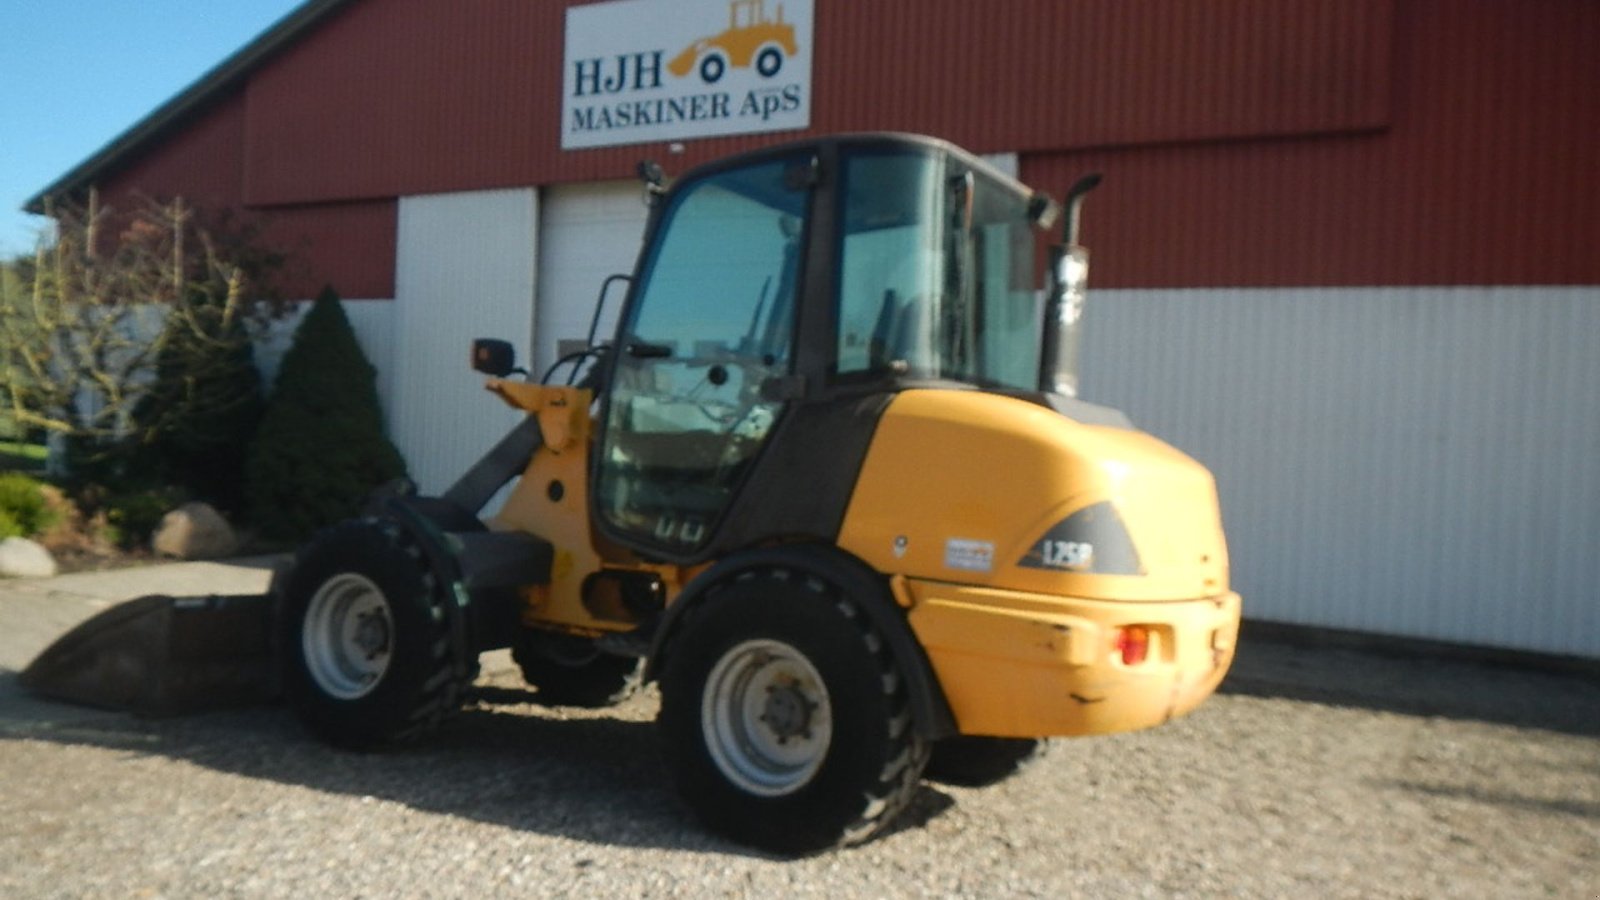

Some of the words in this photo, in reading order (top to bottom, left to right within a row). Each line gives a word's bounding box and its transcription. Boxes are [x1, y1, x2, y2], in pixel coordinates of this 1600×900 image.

[573, 50, 664, 96] HJH
[572, 93, 730, 131] MASKINER
[740, 84, 801, 120] ApS
